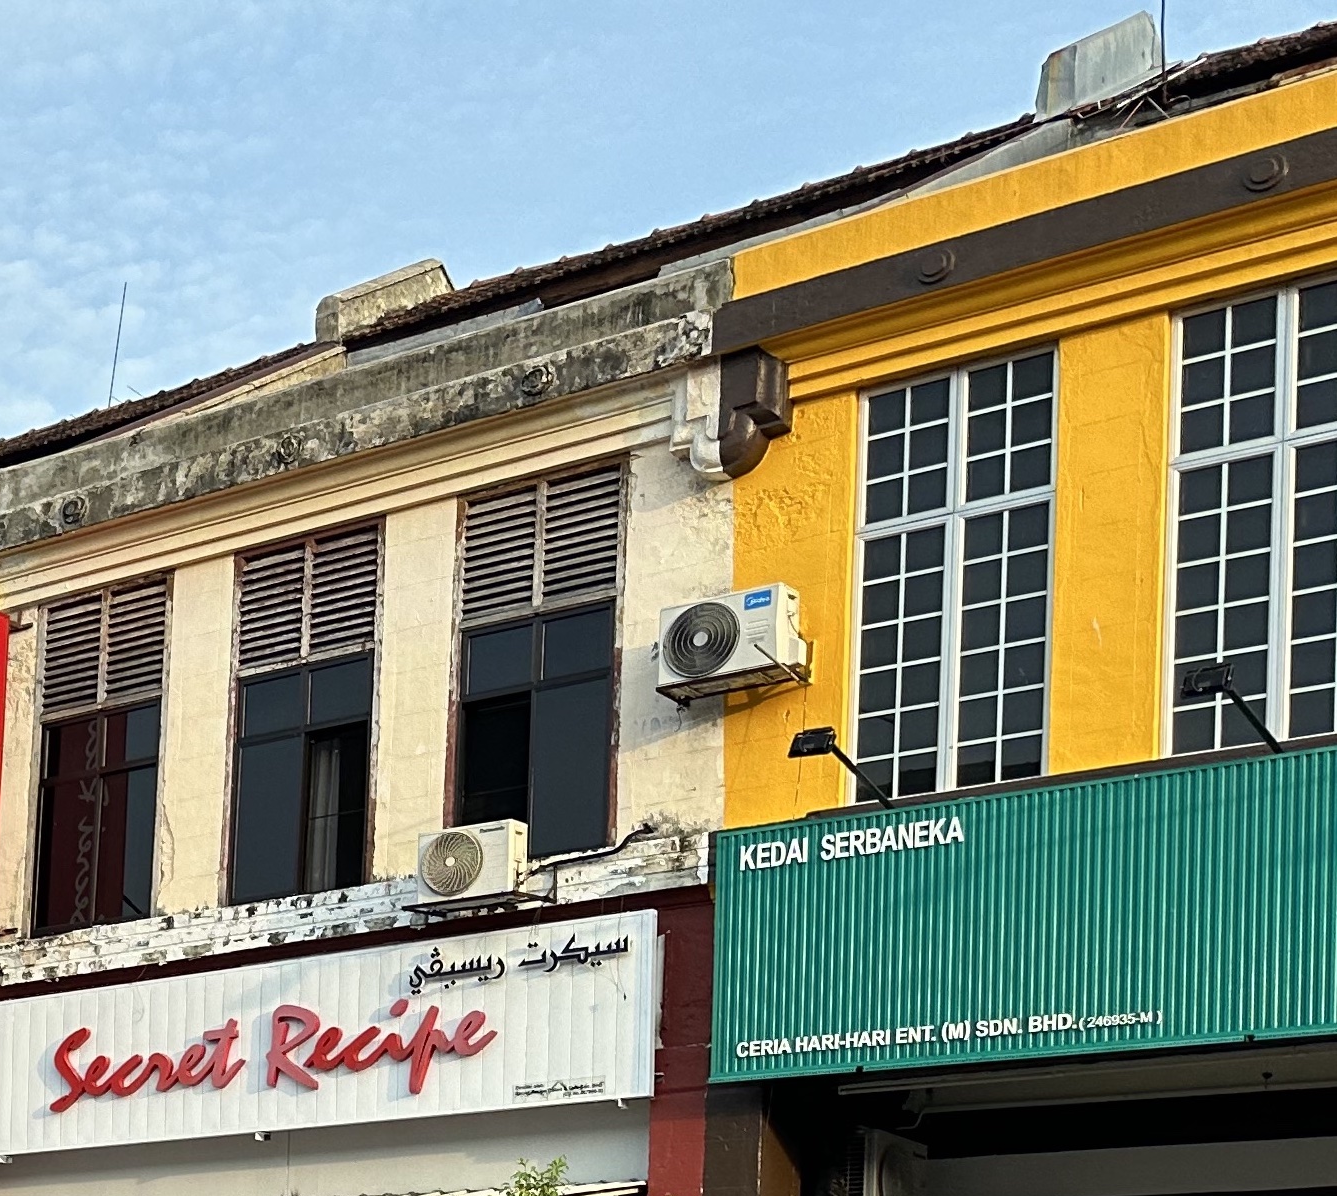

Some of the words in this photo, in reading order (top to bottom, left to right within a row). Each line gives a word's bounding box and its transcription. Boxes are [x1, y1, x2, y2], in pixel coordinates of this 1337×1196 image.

[740, 837, 809, 871] KEDAI
[820, 817, 965, 861] SERBANEKA
[49, 1018, 245, 1112] Secret
[267, 998, 499, 1094] Recipe
[736, 1038, 791, 1058] CERIA
[796, 1028, 890, 1054] HARI-HARI
[896, 1026, 936, 1044] ENT.
[941, 1020, 970, 1043] (M)
[975, 1018, 1023, 1038] SDN.
[1028, 1013, 1077, 1034] BHD.
